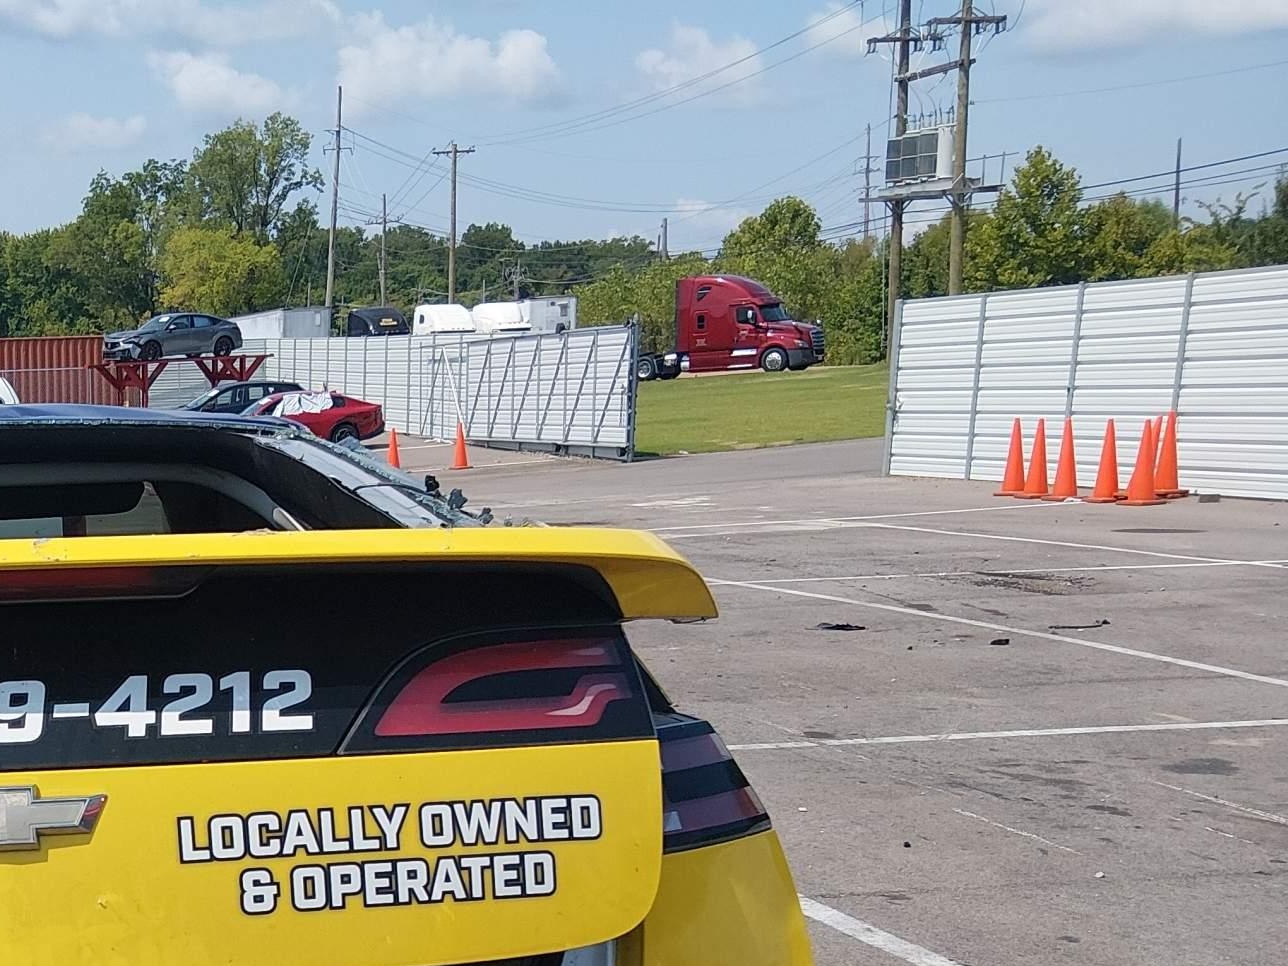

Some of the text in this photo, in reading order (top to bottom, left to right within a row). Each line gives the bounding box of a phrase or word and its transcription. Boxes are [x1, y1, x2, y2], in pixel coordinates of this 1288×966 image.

[177, 794, 603, 865] LOCALLY OWNED
[240, 850, 557, 916] & OPERATED
